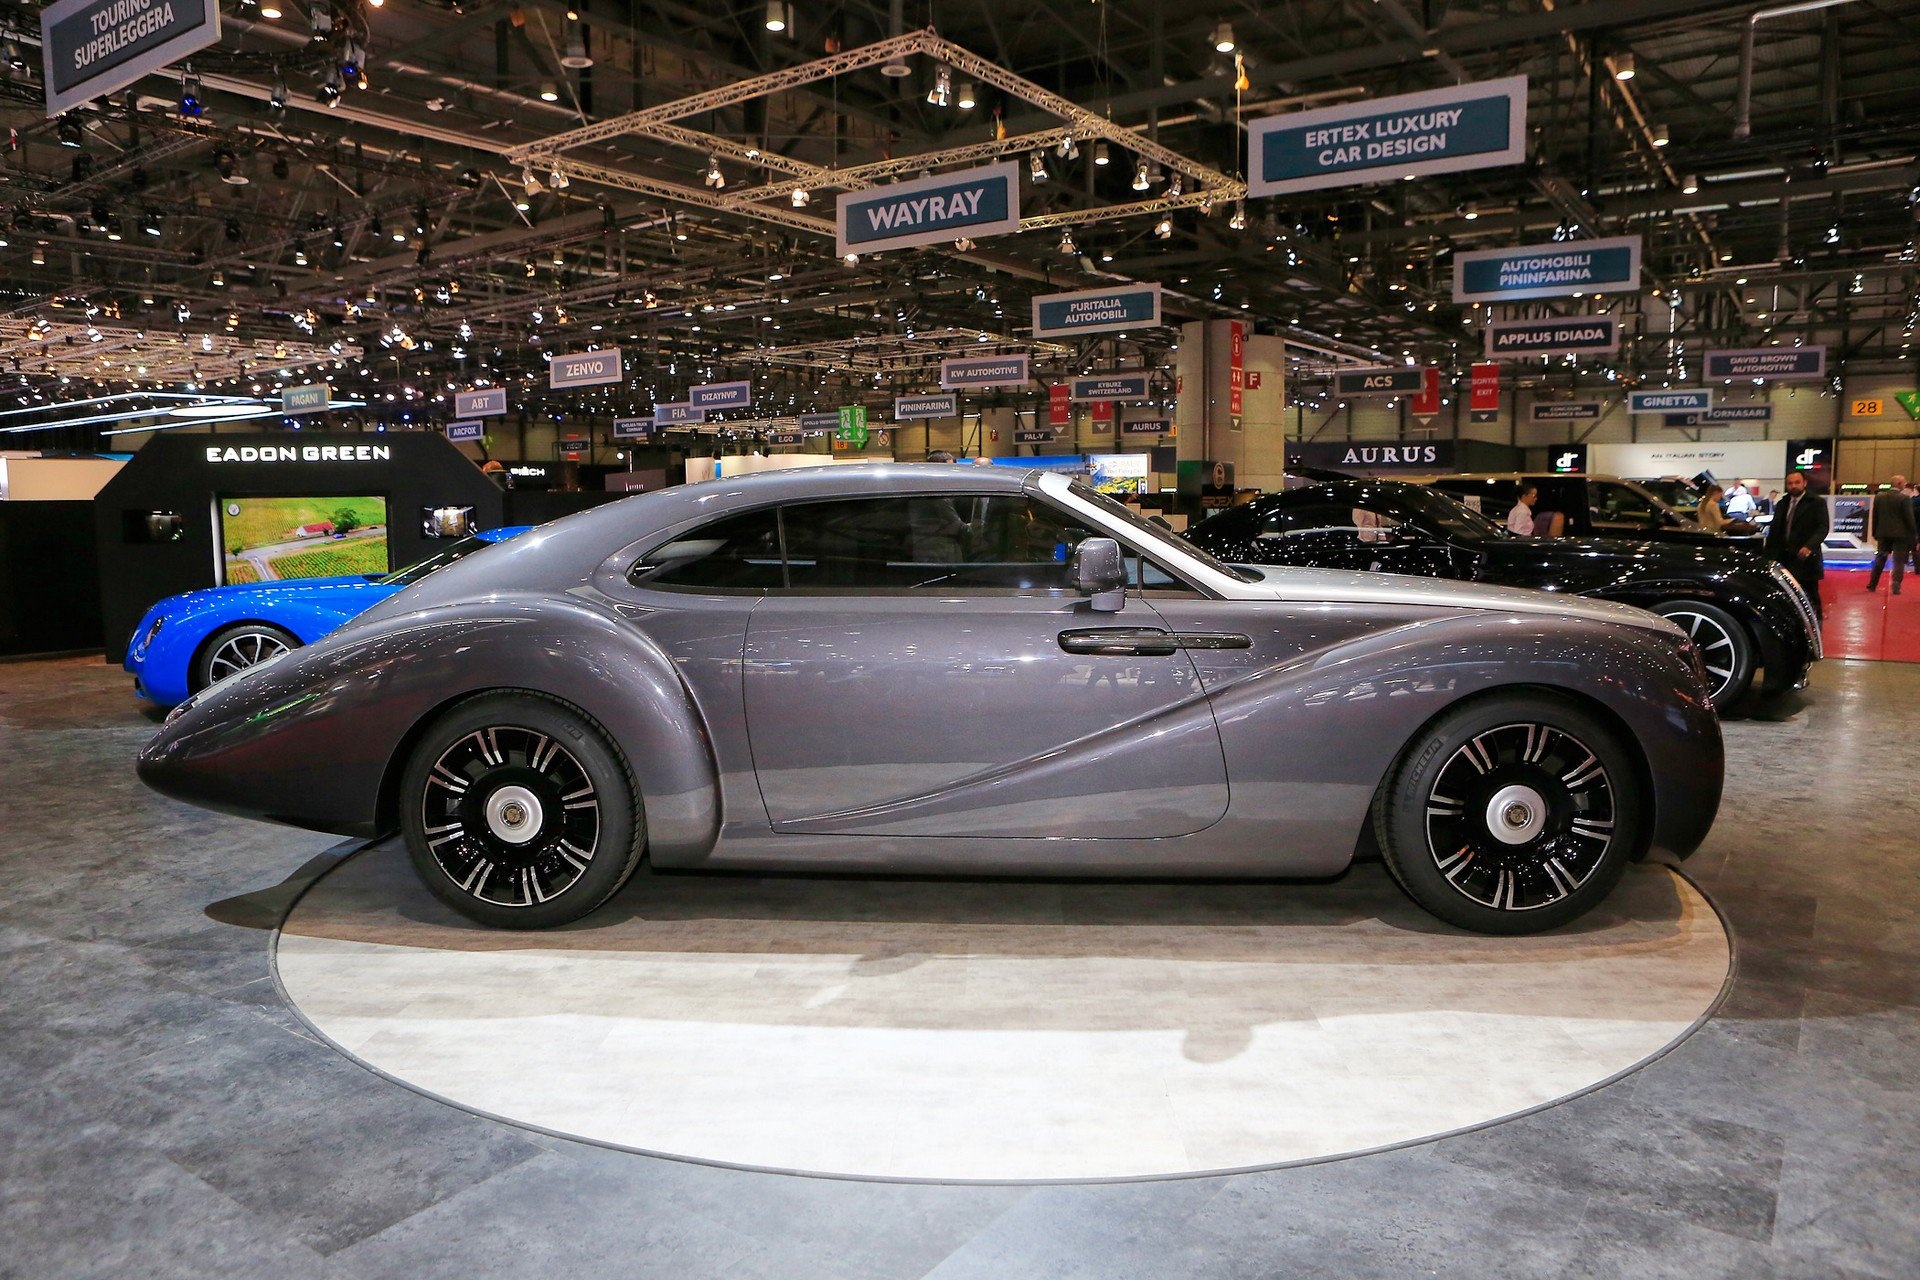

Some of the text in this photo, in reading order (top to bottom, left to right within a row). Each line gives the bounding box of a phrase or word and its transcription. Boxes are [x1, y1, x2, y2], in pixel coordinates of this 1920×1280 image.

[74, 2, 175, 70] SUPERLEGGERA
[1305, 108, 1463, 148] ERTEX LUXURY
[1318, 133, 1446, 166] CAR DESIGN
[867, 188, 985, 231] WAYRAY
[1500, 254, 1591, 272] AUTOMOBILI
[1499, 268, 1592, 286] PININFARINA
[1070, 298, 1121, 312] PURITALIA
[1065, 309, 1127, 323] AUTOMOBILI
[1498, 328, 1605, 345] APPLUS IDIADA
[1730, 354, 1798, 365] DAVID BROWN
[566, 361, 603, 377] ZENVO
[951, 366, 1018, 378] KW AUTOMOTIVE
[1732, 364, 1795, 373] AUTOMOTIVE
[1250, 373, 1258, 385] F
[1364, 375, 1393, 388] ACS
[701, 390, 738, 401] DIZAYNVIP
[1088, 387, 1132, 395] SWITZERLAND
[291, 392, 319, 406] PAGANI
[471, 397, 489, 410] ABT
[1642, 395, 1698, 407] GINETTA
[671, 408, 687, 419] FIA
[900, 401, 951, 412] PININFARINA
[1857, 401, 1877, 413] 28
[453, 427, 477, 436] ARCFOX
[1132, 422, 1161, 431] AURUS
[206, 446, 390, 462] EADON GREEN
[1342, 446, 1437, 464] AURUS
[1556, 452, 1579, 468] dr
[1795, 448, 1822, 465] dr
